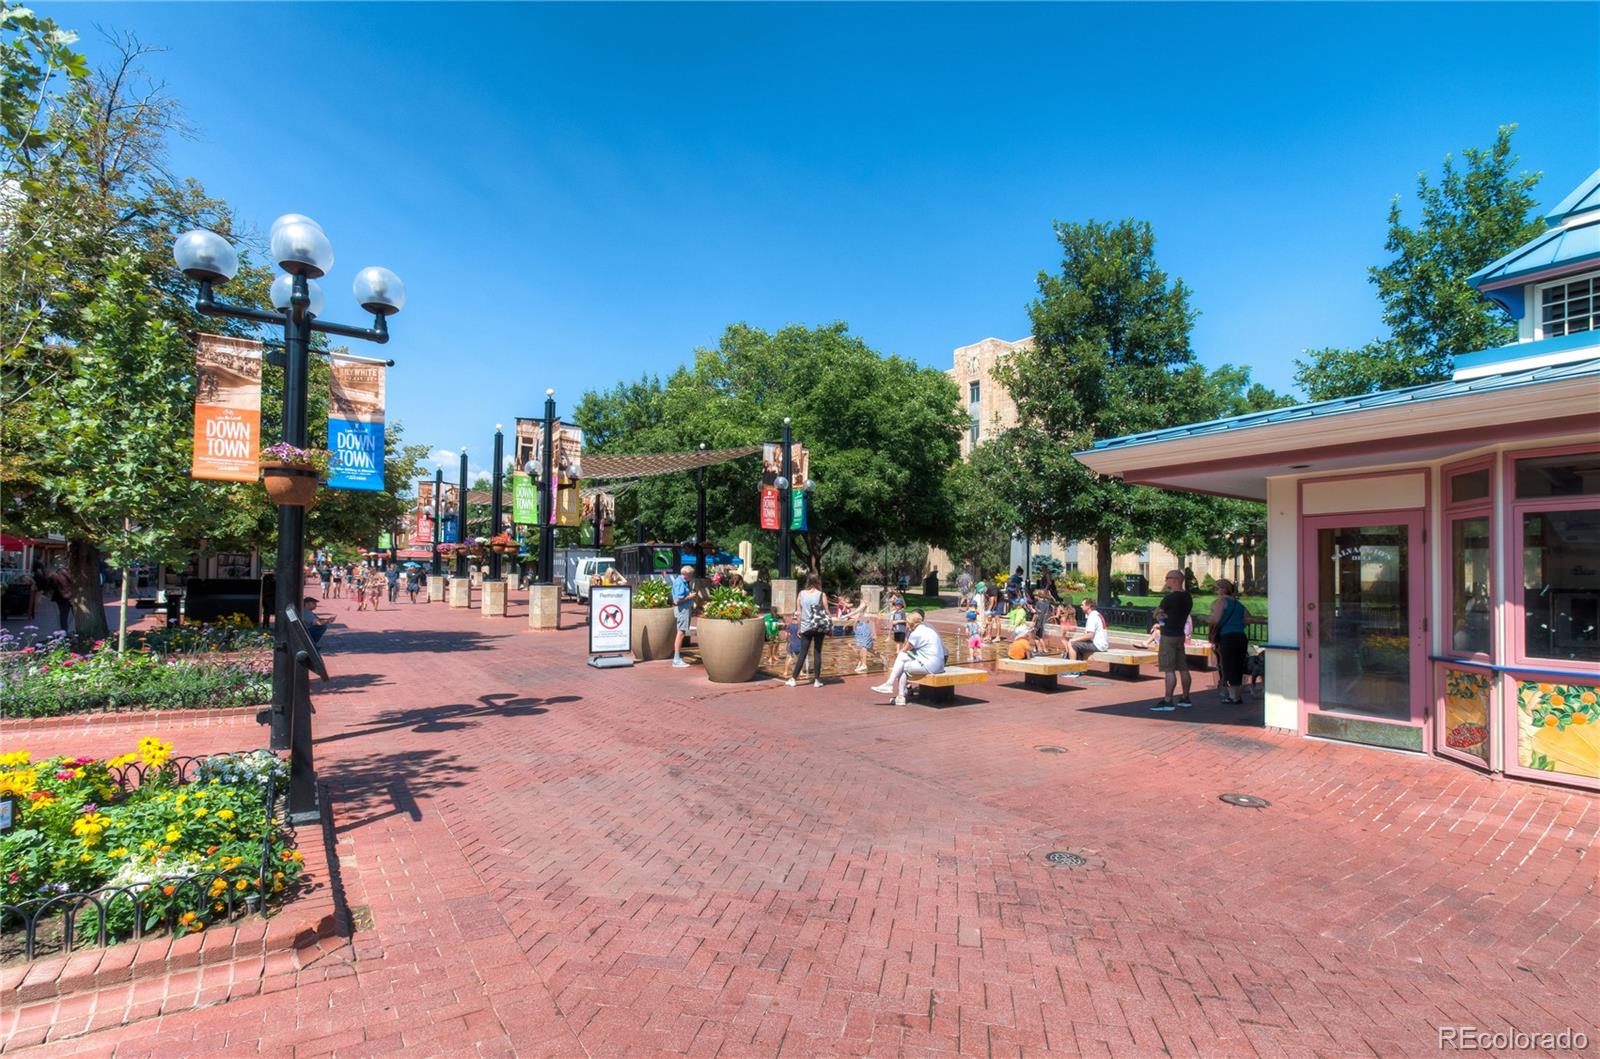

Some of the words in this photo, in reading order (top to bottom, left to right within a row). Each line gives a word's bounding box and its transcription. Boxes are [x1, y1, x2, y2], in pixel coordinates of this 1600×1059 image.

[206, 419, 250, 440] DOWN
[206, 438, 250, 458] TOWN
[337, 432, 375, 450] DOWN
[337, 449, 375, 469] TOWN
